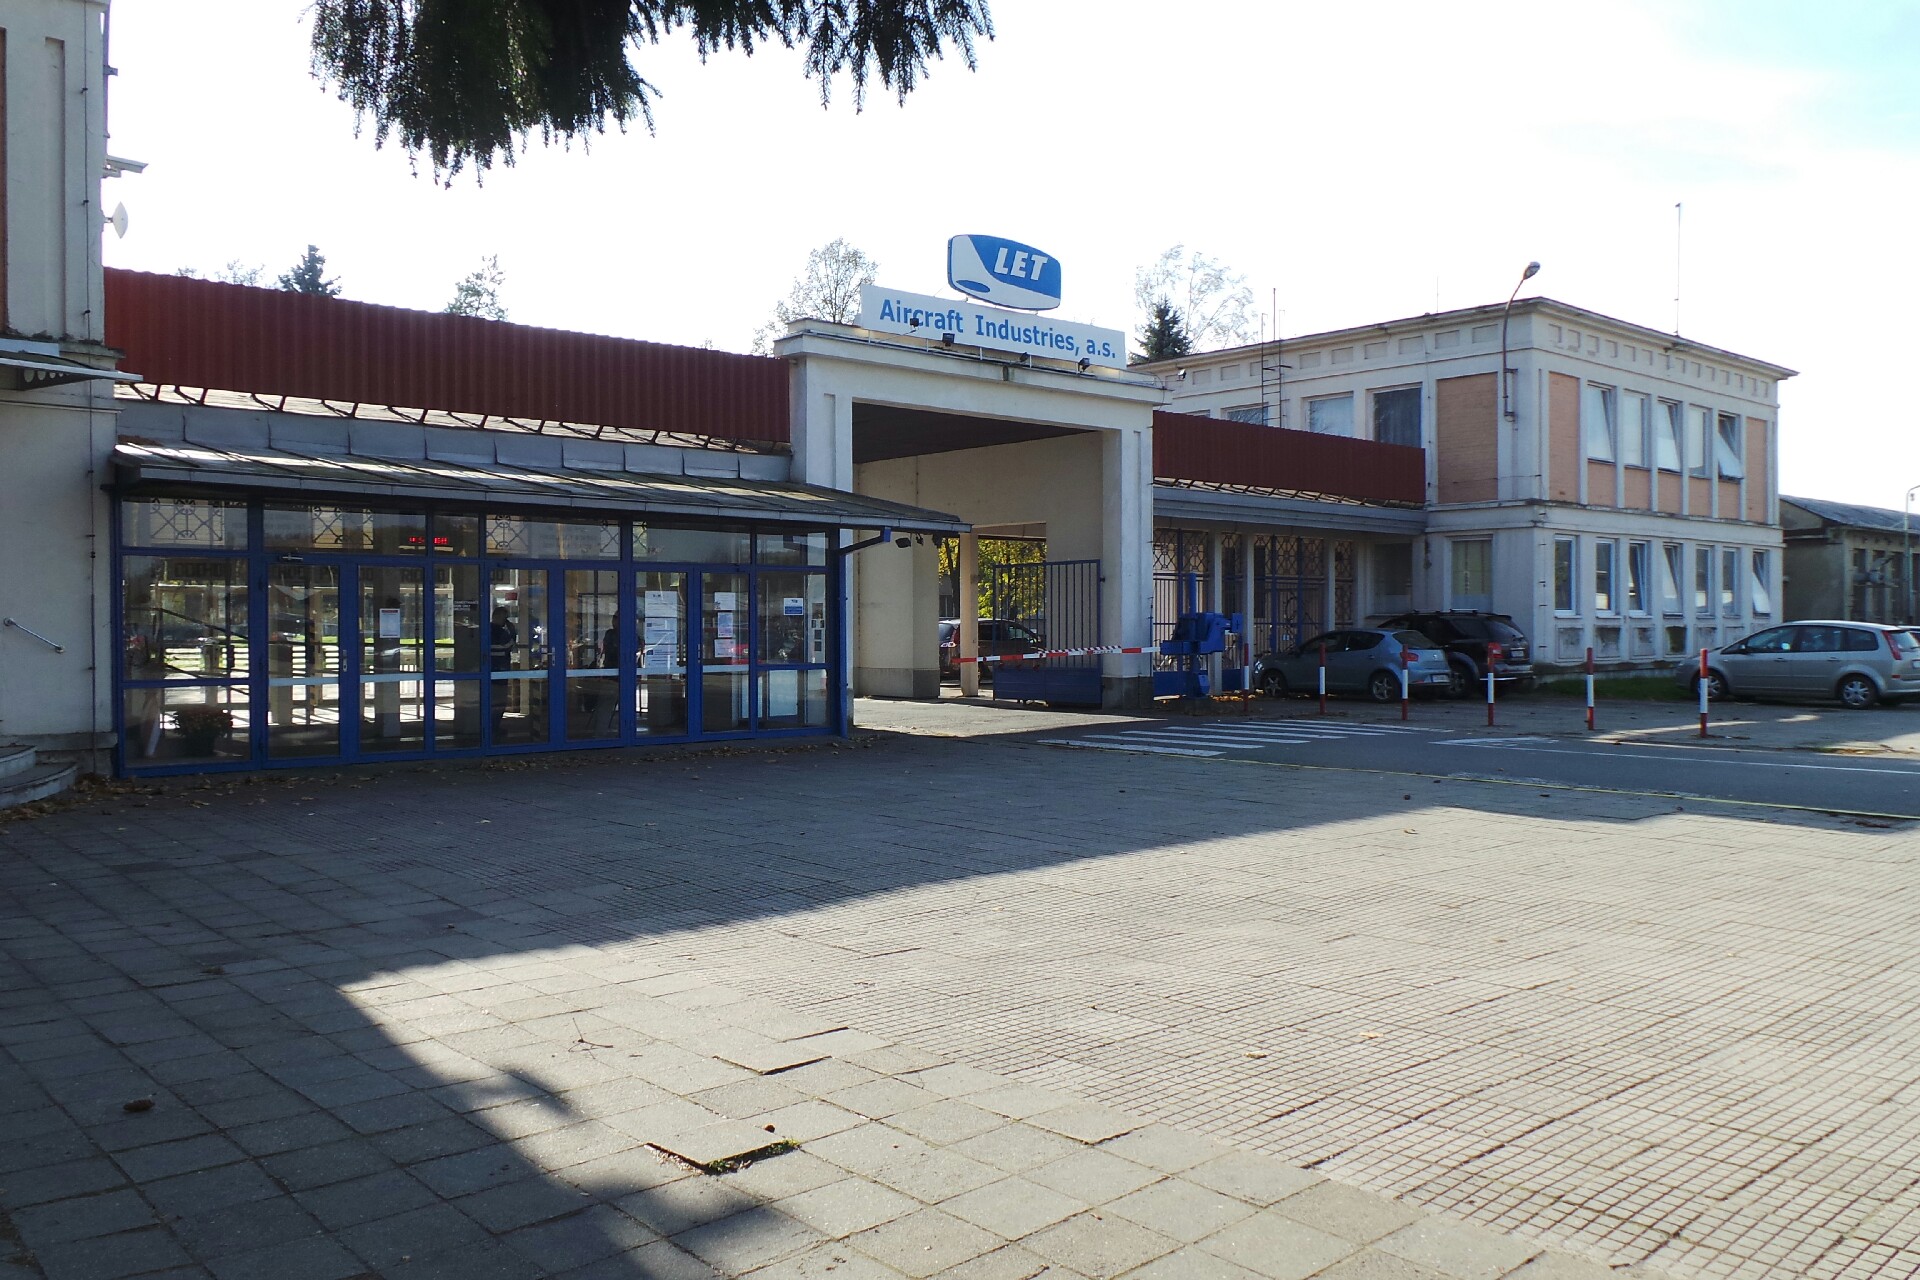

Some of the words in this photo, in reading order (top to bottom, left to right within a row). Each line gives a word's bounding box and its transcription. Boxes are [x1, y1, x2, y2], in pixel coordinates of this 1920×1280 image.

[994, 247, 1048, 281] LET
[880, 299, 964, 333] Aircraft
[975, 314, 1080, 357] Industries,
[1086, 339, 1116, 358] a.s.
